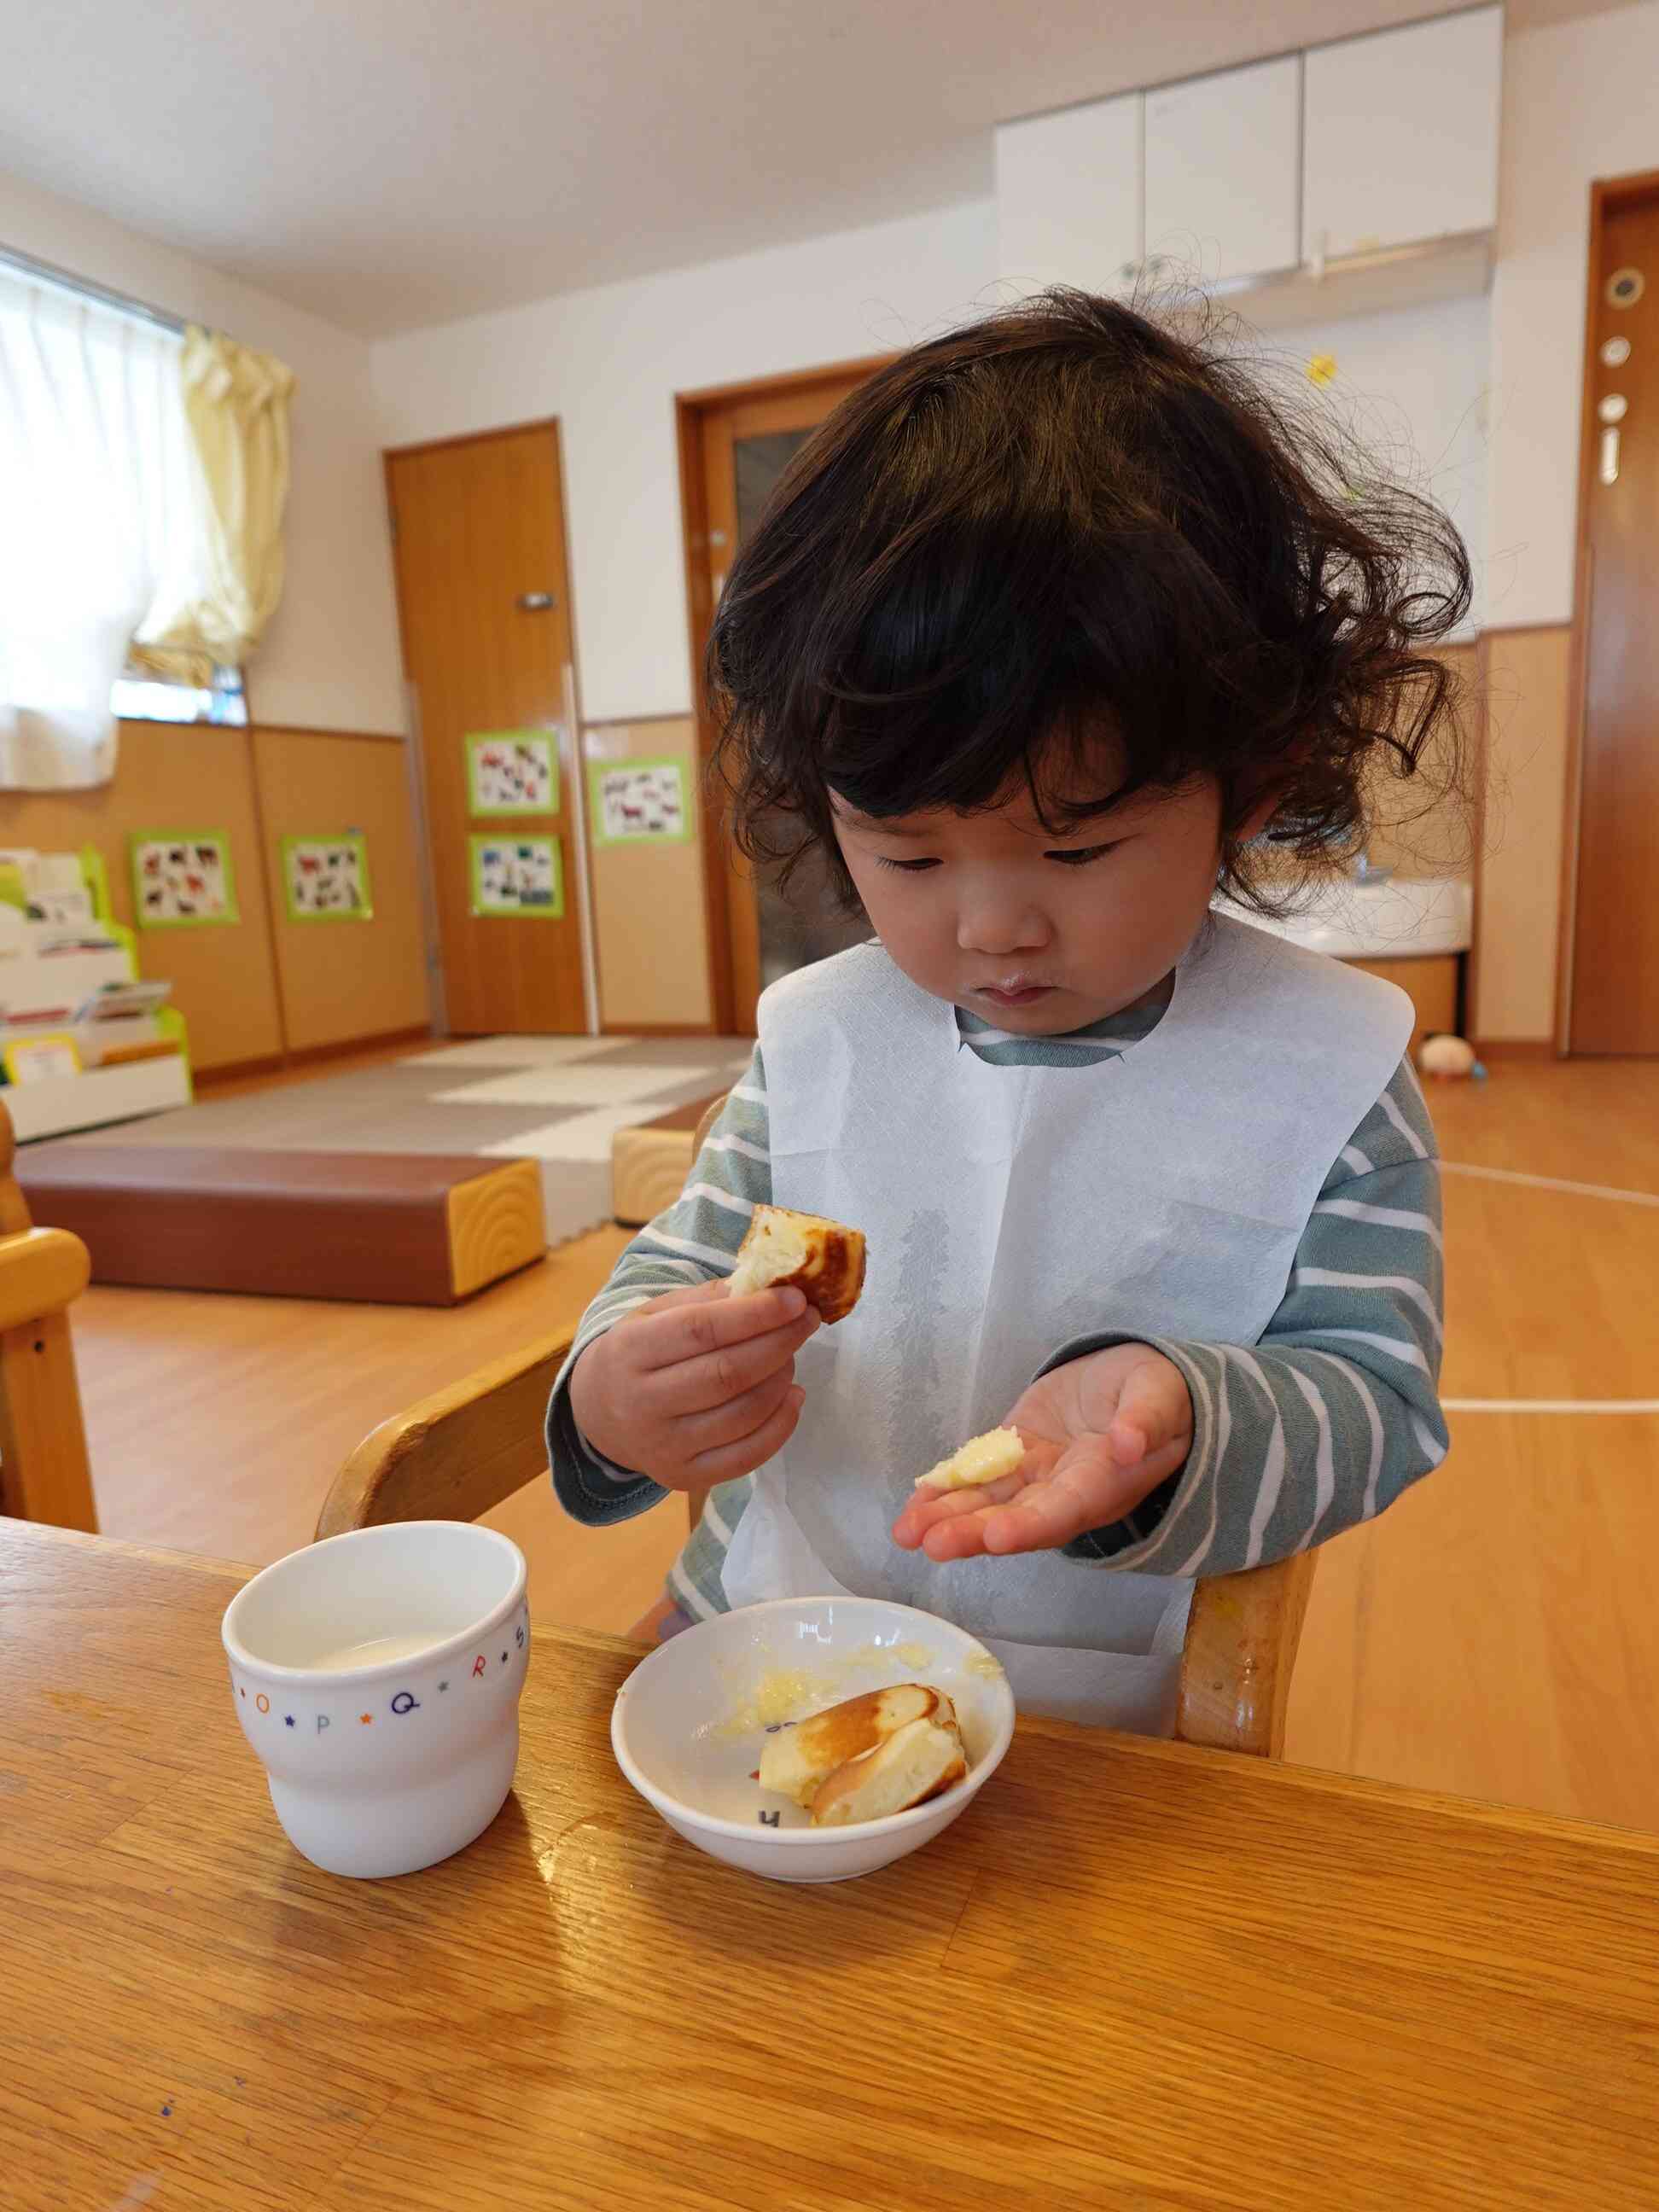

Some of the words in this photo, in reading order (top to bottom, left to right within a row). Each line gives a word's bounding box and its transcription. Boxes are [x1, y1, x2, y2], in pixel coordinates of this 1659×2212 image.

[256, 1693, 270, 1714] O
[317, 1715, 329, 1734] P
[391, 1692, 421, 1714] Q
[472, 1655, 486, 1677] R
[515, 1626, 525, 1649] S
